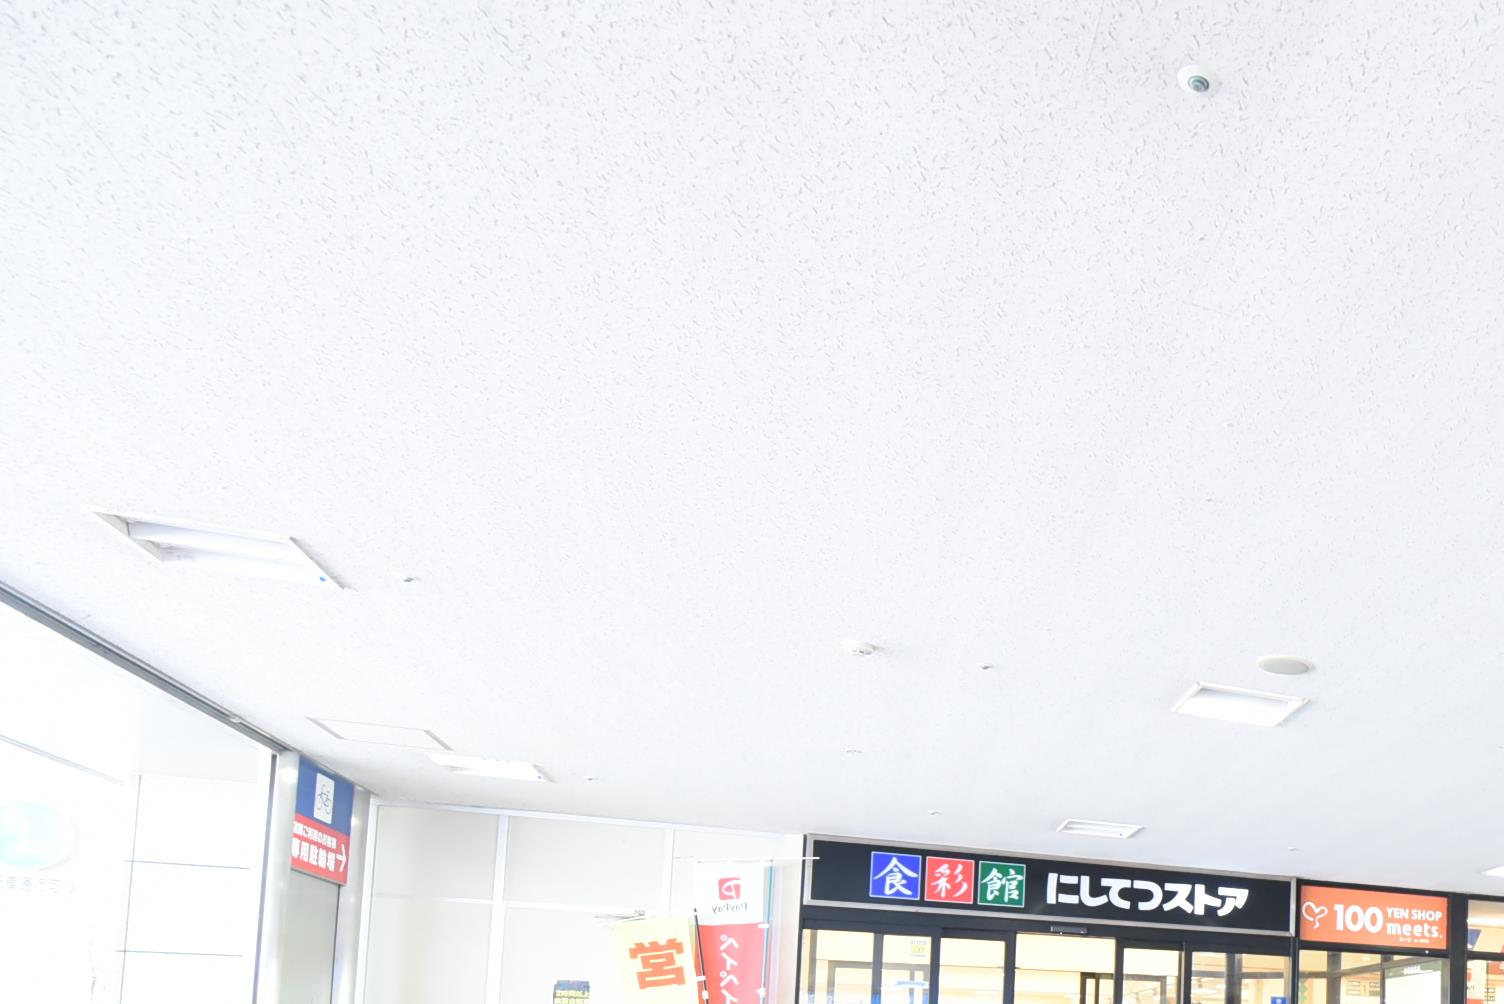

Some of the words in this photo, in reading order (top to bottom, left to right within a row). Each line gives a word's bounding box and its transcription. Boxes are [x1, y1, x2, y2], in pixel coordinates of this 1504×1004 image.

[872, 856, 1022, 904] 食彩館
[1046, 872, 1249, 917] にしてつストア
[1333, 903, 1384, 934] 100
[1386, 906, 1409, 920] YEN
[1411, 909, 1443, 922] SHOP
[1386, 922, 1443, 939] meets.
